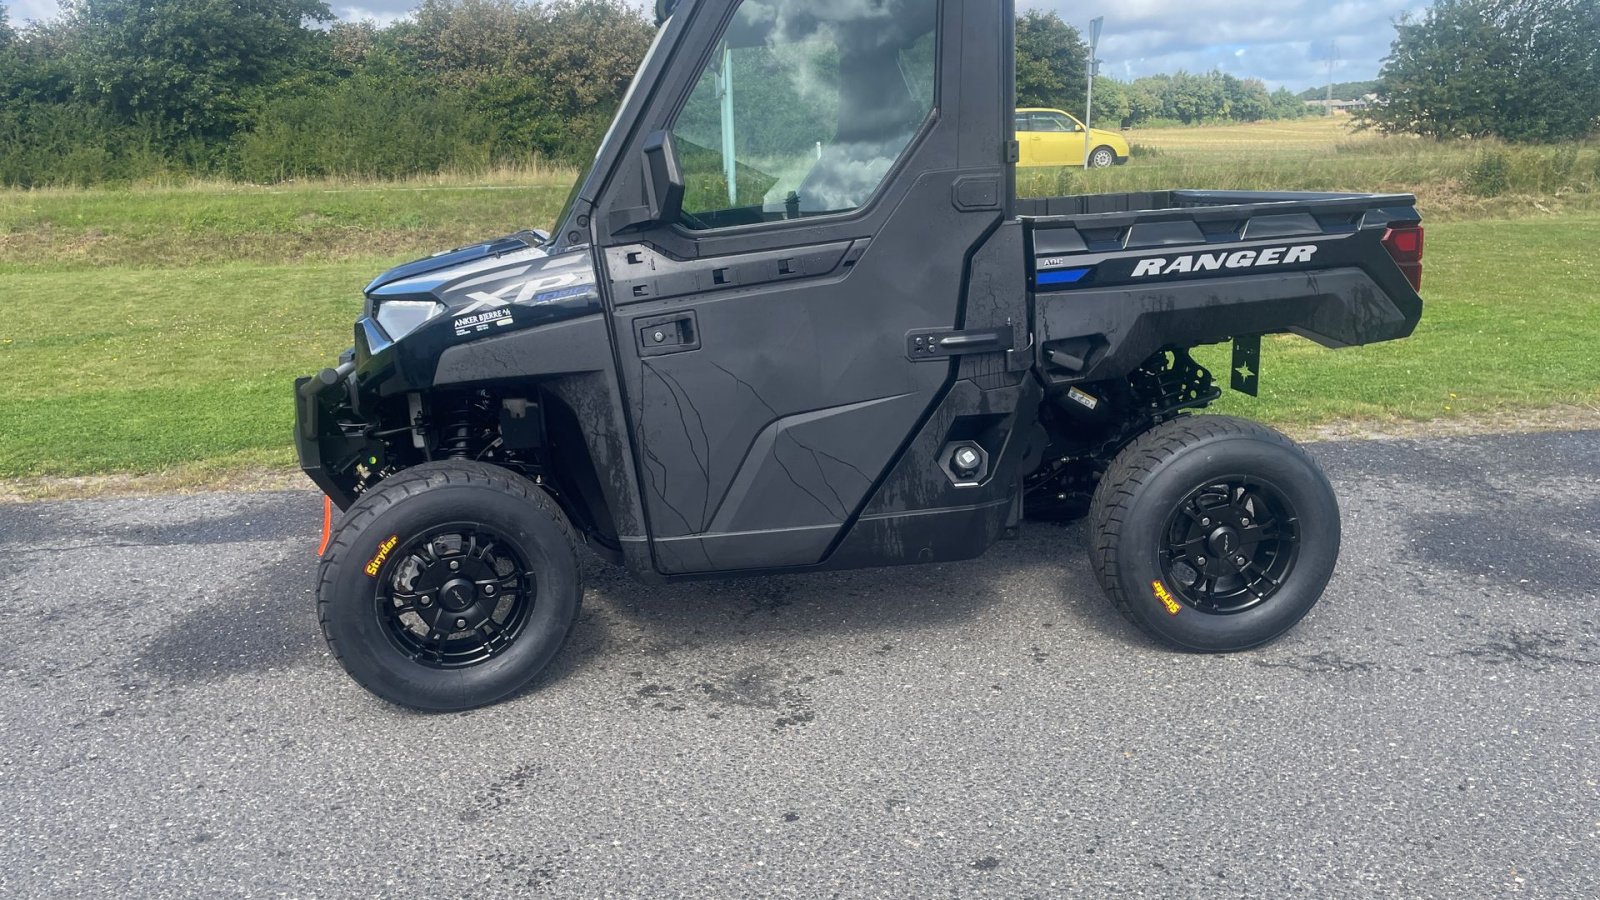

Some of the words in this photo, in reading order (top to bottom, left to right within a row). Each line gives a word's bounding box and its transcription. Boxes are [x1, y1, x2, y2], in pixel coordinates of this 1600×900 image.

[1130, 245, 1318, 277] RANGER
[452, 273, 577, 317] XP
[454, 315, 478, 328] ANKER
[478, 310, 502, 324] BJERRE
[366, 536, 397, 576] Stryder
[1152, 581, 1180, 614] Stryder
